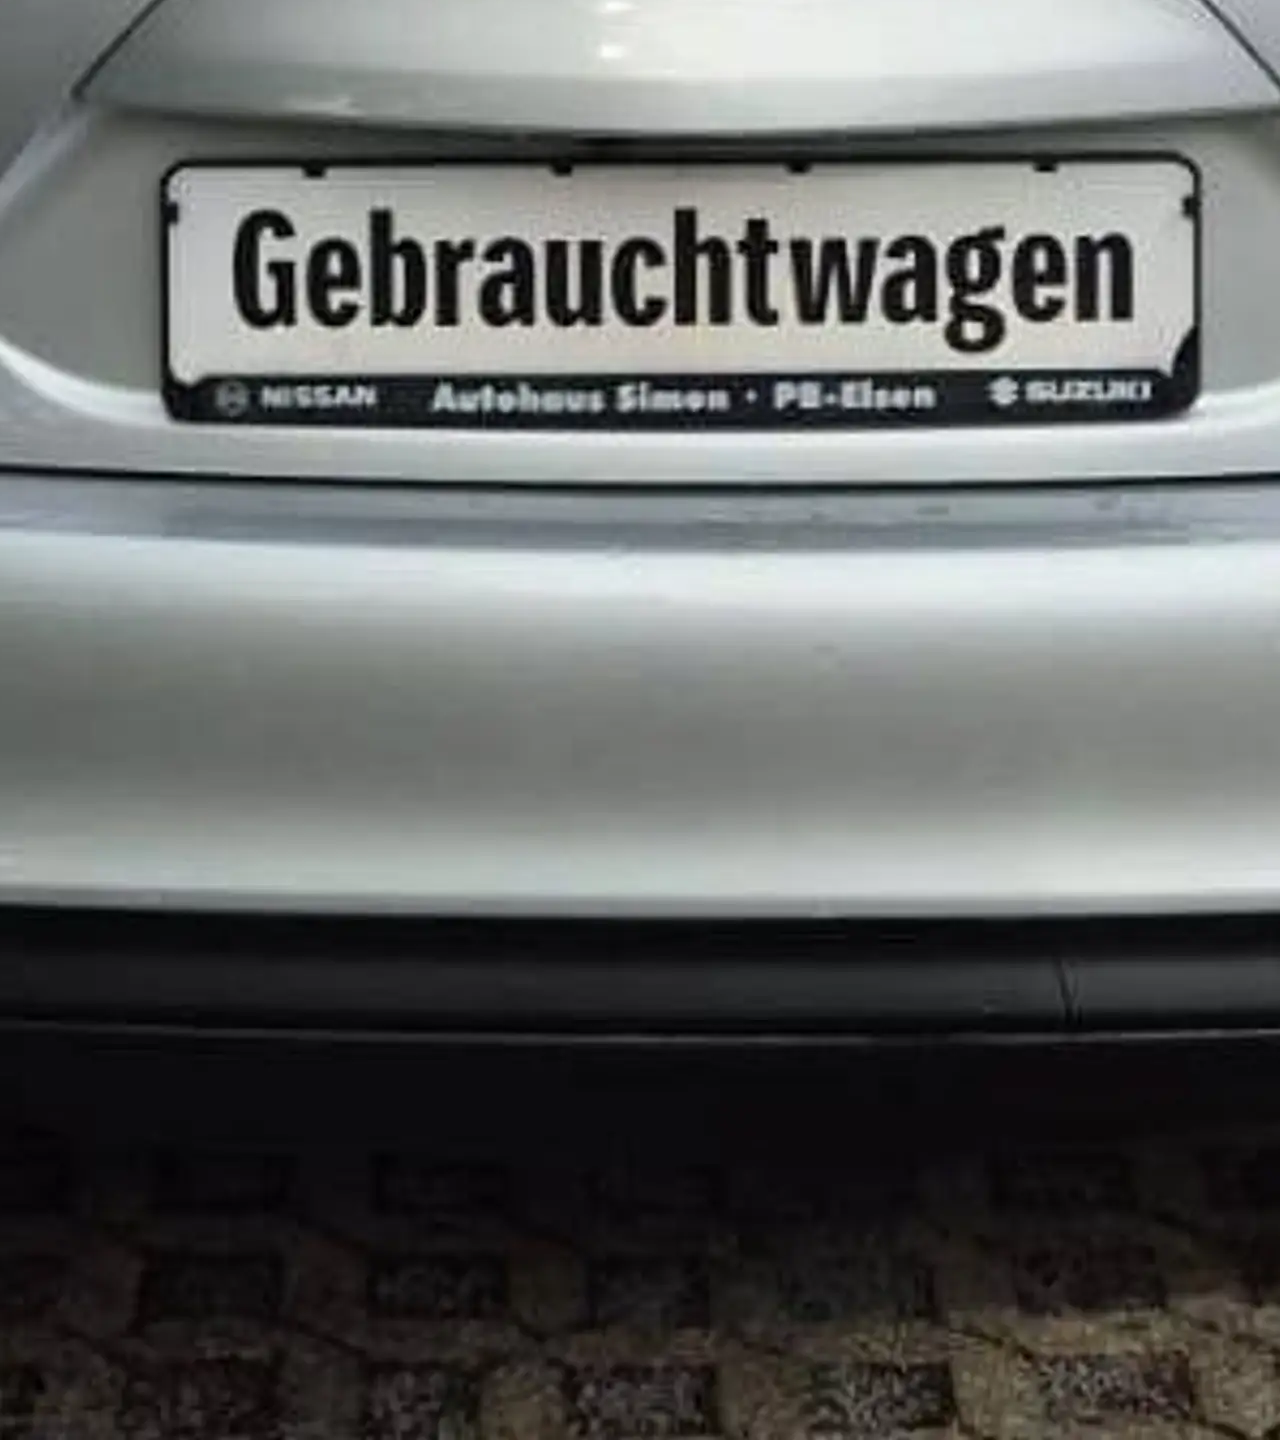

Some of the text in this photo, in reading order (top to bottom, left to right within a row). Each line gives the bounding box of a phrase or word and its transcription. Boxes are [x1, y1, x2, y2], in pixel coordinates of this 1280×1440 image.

[231, 207, 1136, 353] Gebrauchtwagen
[260, 383, 378, 409] NISSAN
[430, 380, 605, 413] Autohaus
[616, 381, 730, 412] Simon
[1025, 379, 1152, 402] SUZUKI
